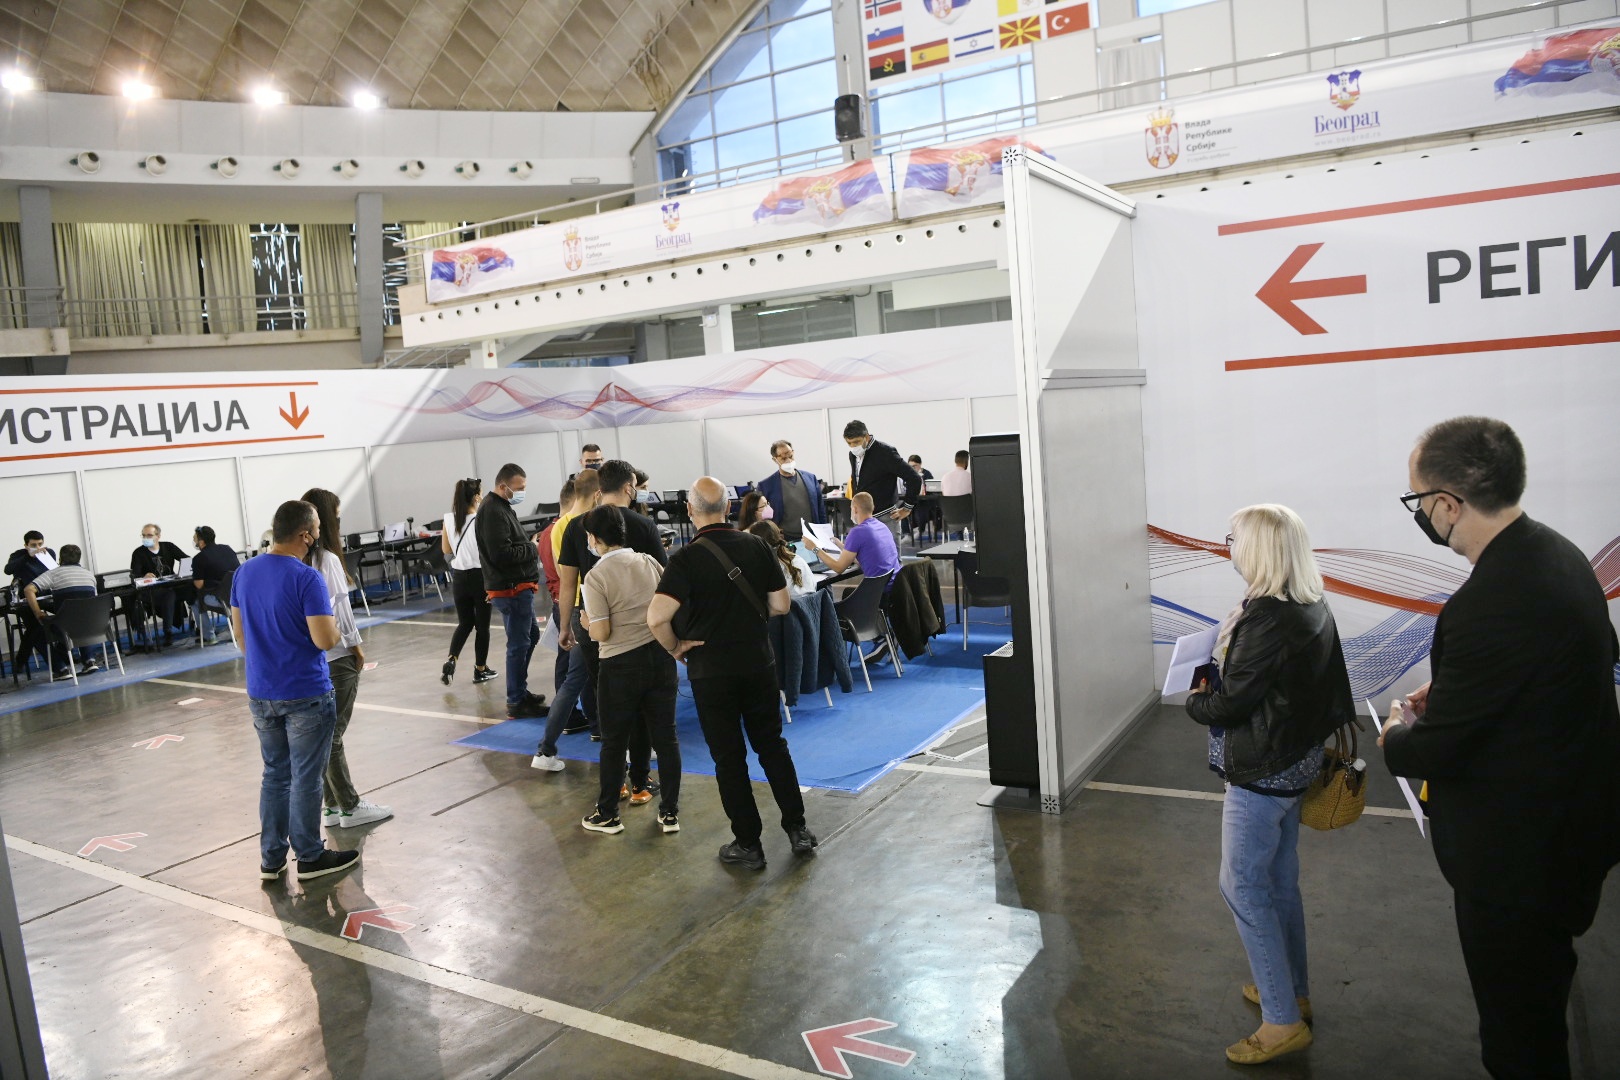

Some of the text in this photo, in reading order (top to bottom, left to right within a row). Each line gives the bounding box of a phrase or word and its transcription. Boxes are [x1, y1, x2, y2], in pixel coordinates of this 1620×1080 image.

[1185, 119, 1211, 129] Влада
[1314, 111, 1380, 133] Београд
[1185, 127, 1233, 140] Републике
[1186, 141, 1216, 152] Србије
[1427, 231, 1620, 304] РЕГИ
[392, 529, 398, 537] 7
